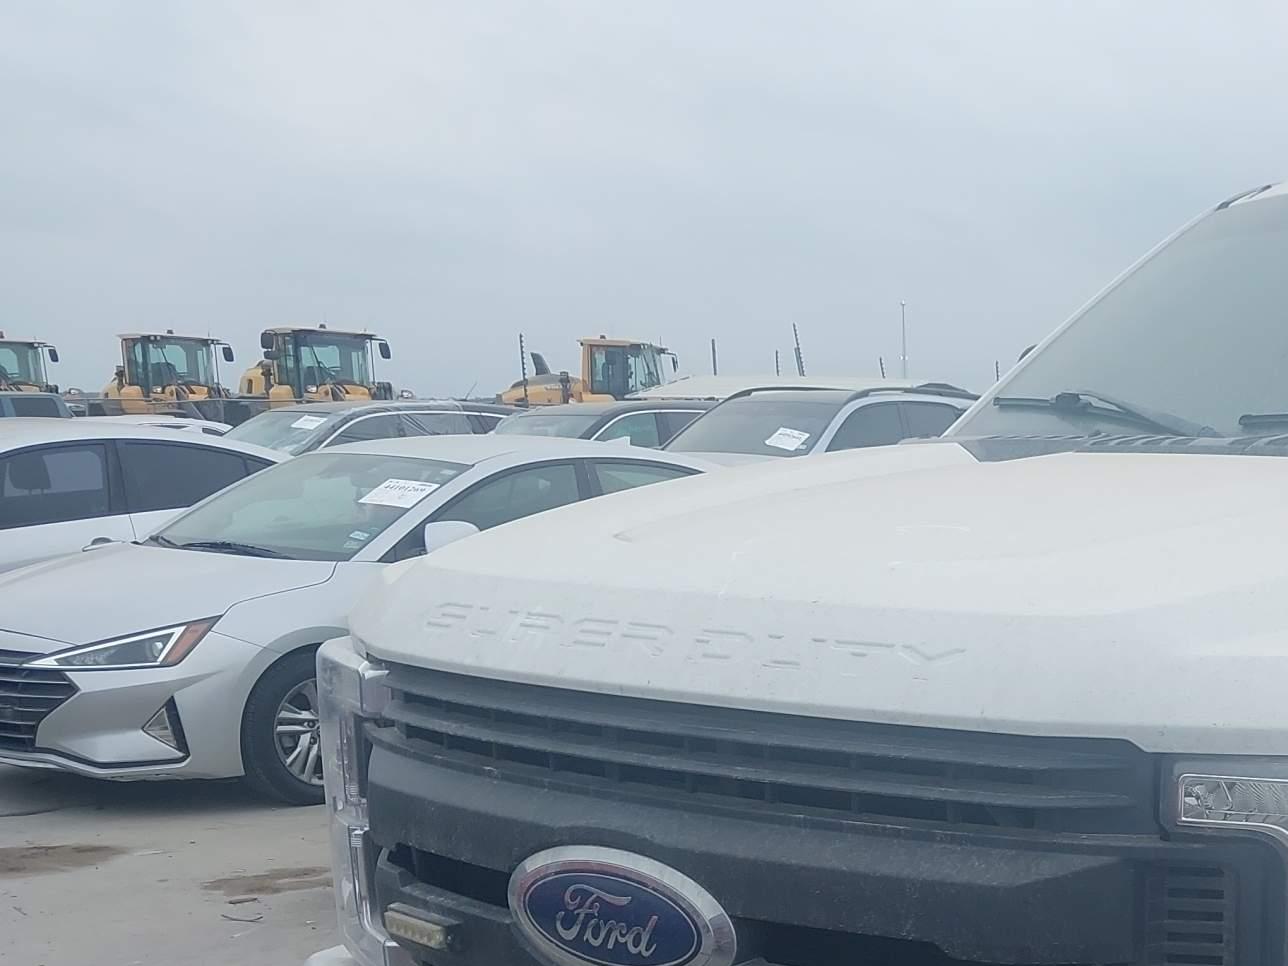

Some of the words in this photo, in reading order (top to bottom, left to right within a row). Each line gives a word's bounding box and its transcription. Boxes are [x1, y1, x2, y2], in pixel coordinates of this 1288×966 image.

[423, 602, 675, 658] SUPER
[684, 628, 967, 680] DUTY
[555, 883, 659, 958] Ford
